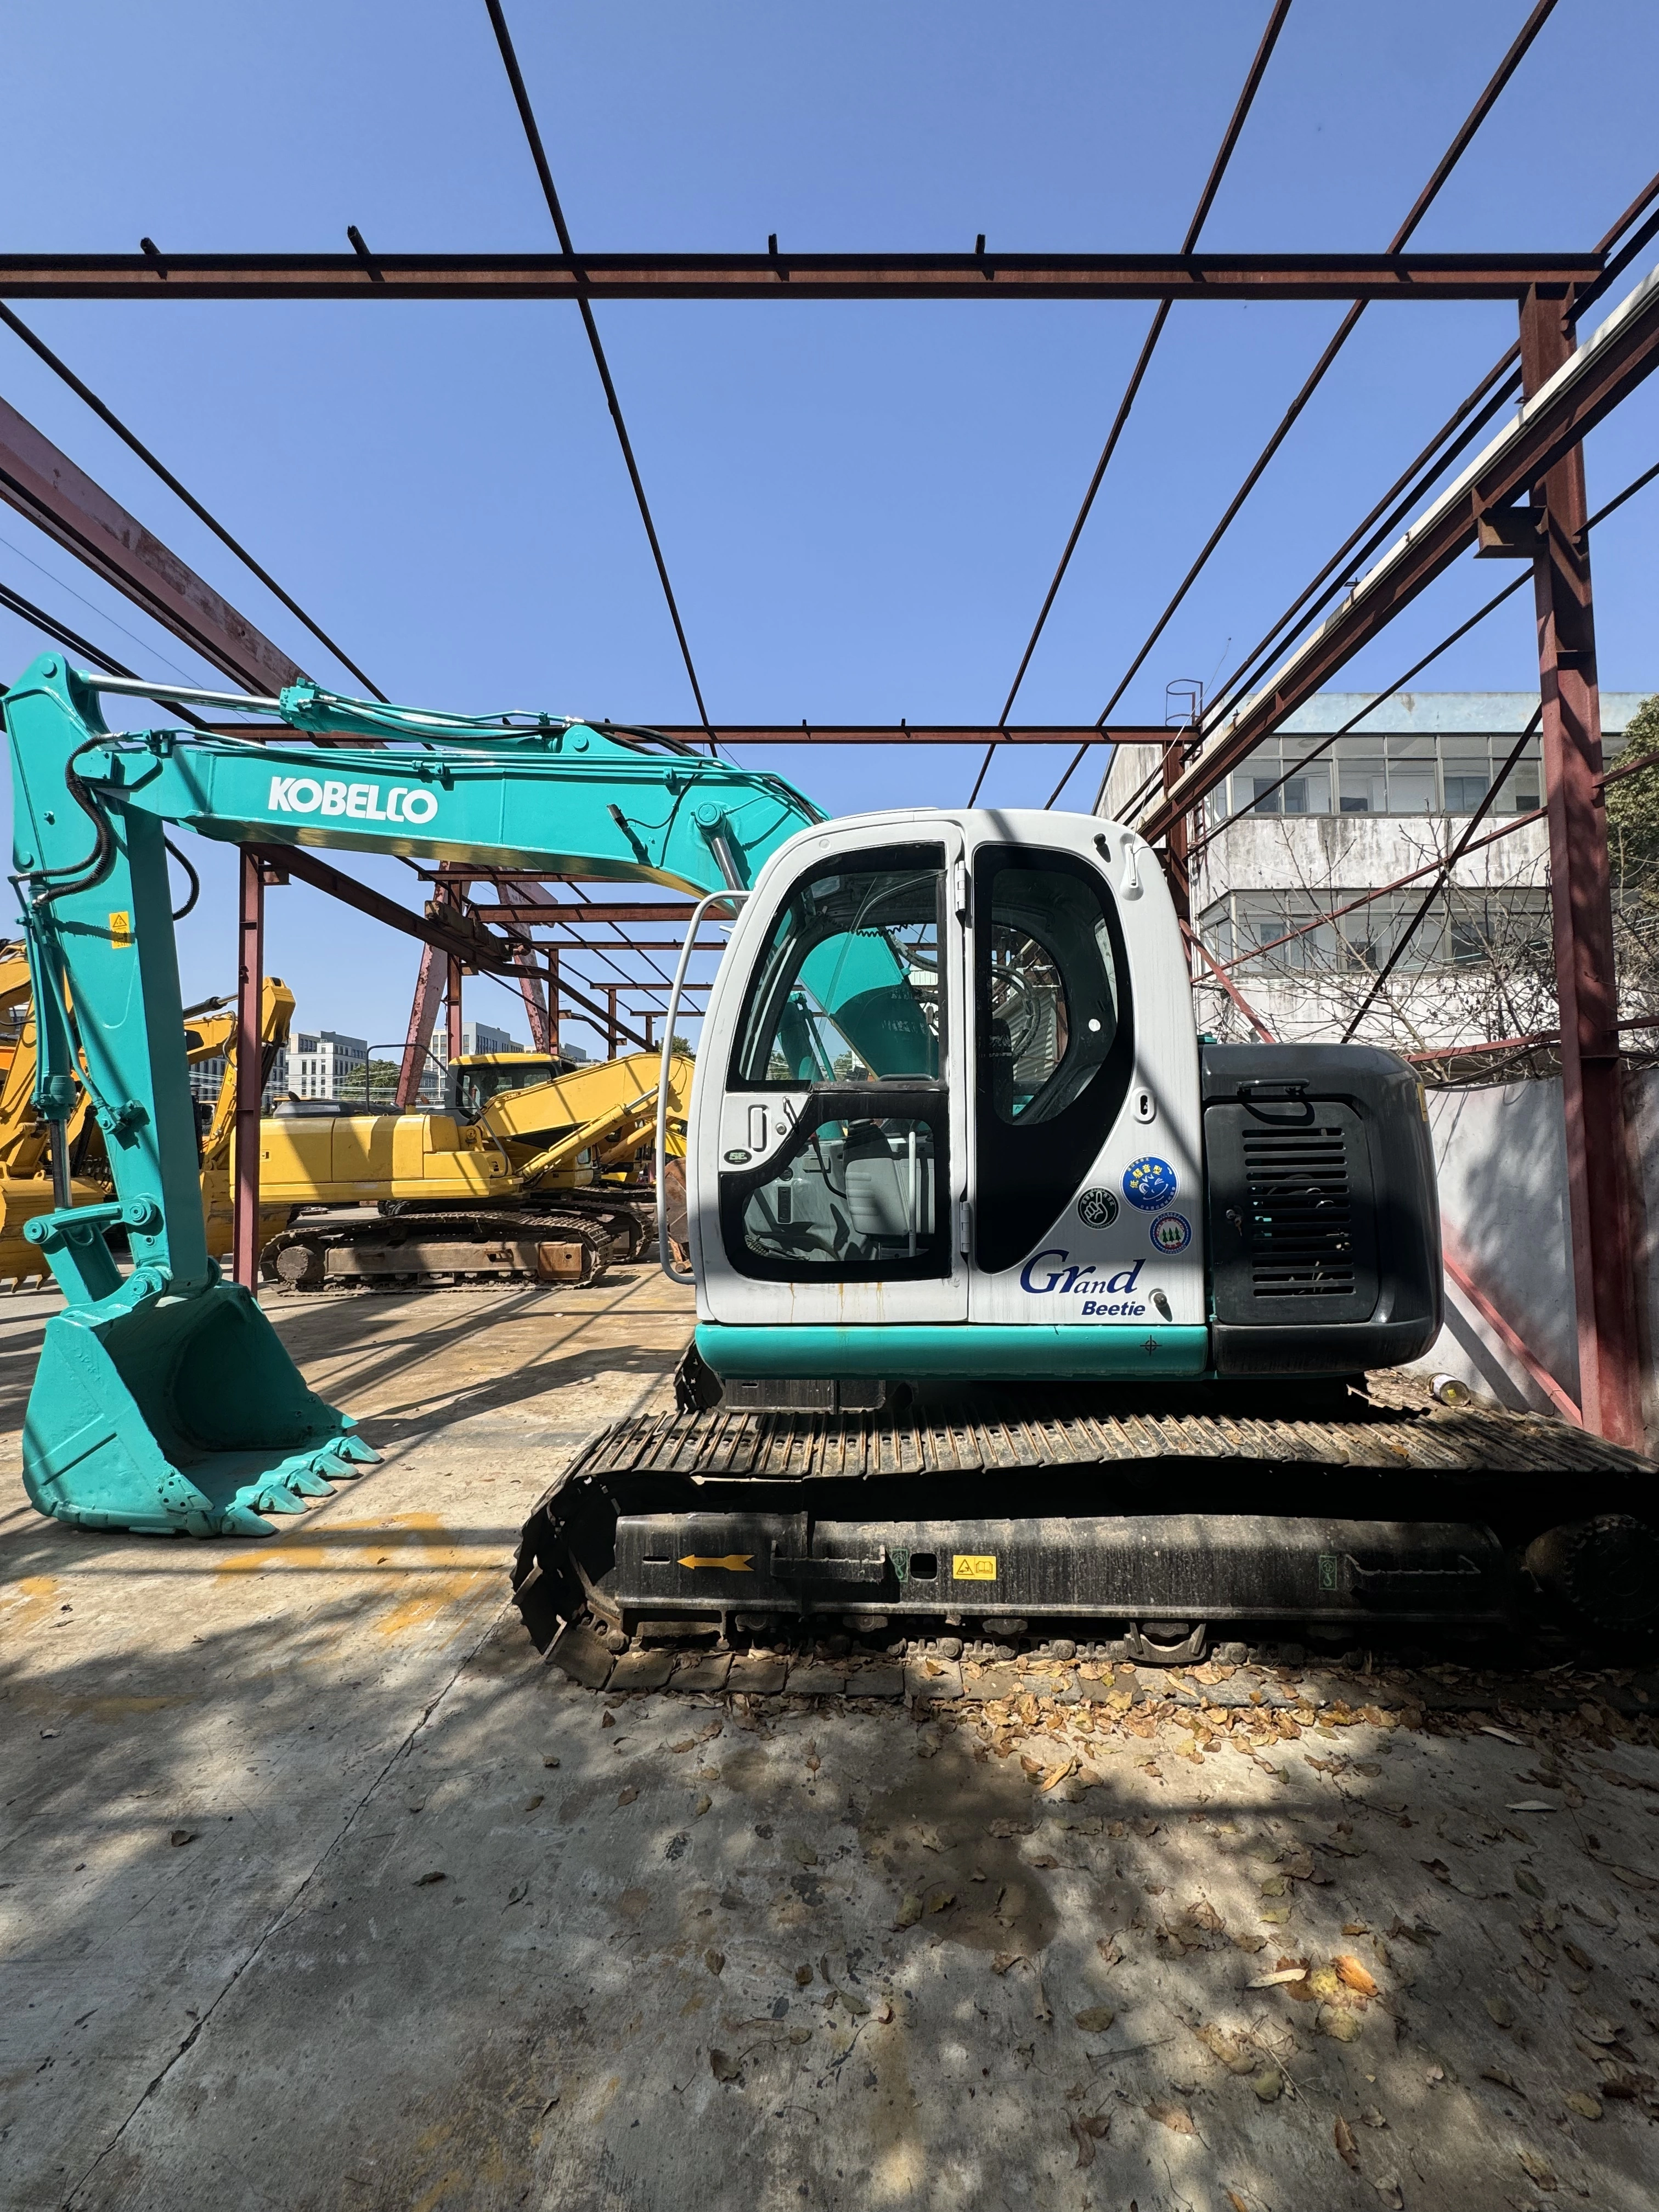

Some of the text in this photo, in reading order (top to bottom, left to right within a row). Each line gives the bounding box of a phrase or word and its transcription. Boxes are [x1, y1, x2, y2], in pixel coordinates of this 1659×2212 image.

[268, 776, 438, 823] KOBELCO
[1020, 1249, 1146, 1294] Grand
[1081, 1301, 1146, 1316] Beetie
